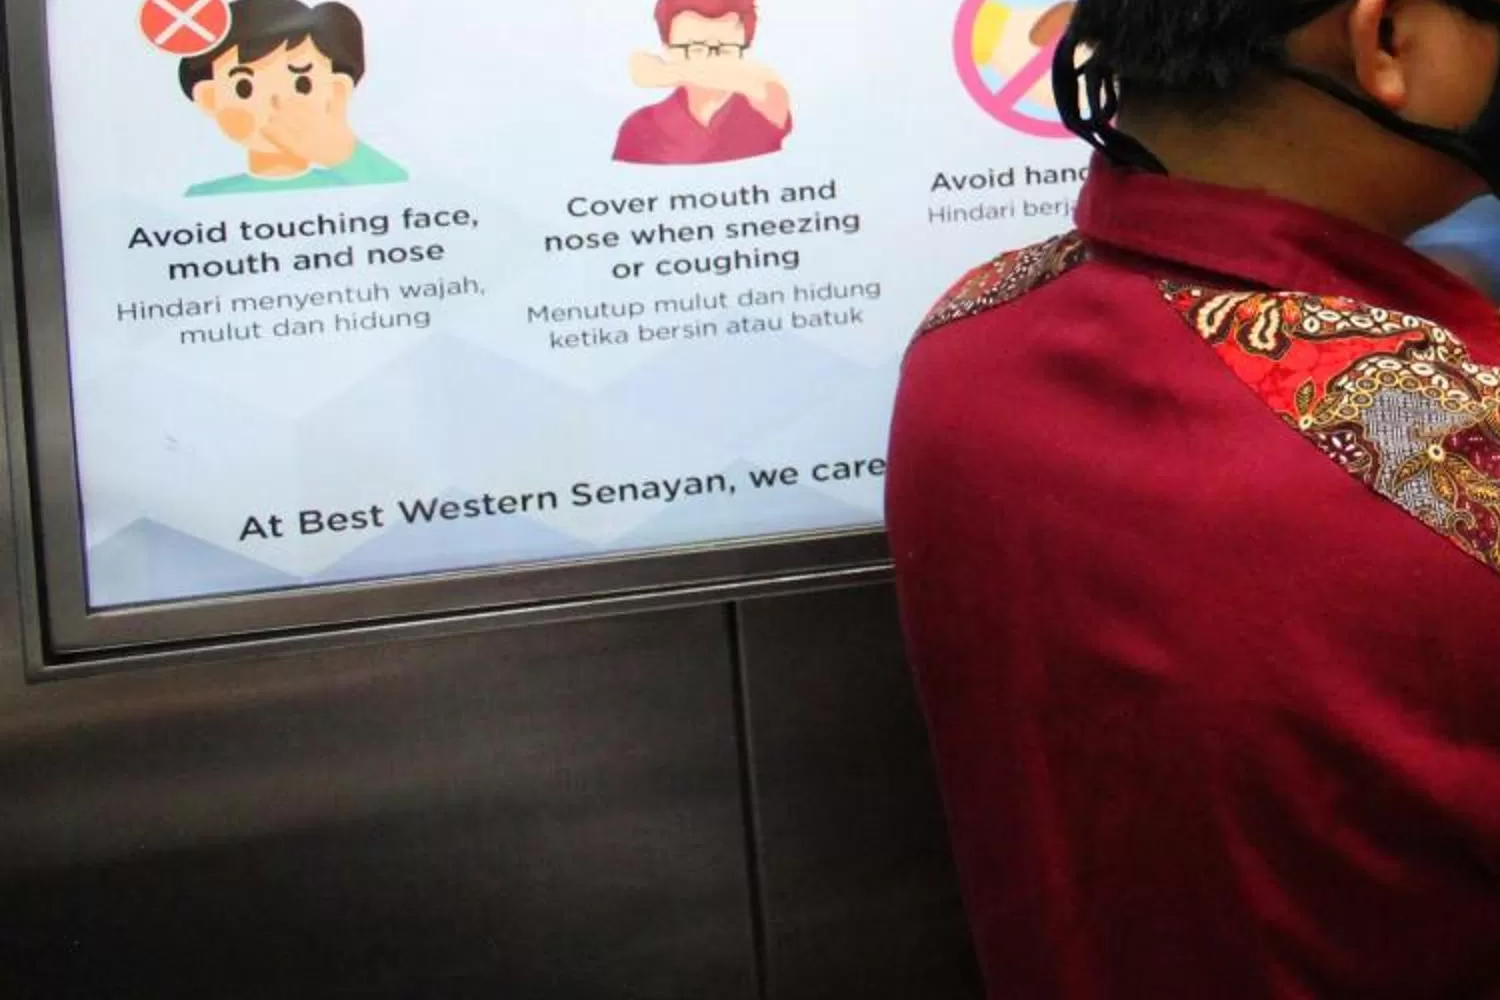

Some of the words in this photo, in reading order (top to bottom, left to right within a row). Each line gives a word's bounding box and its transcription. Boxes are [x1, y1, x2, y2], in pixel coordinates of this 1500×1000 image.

[566, 196, 659, 218] Cover
[669, 183, 770, 211] mouth
[780, 179, 837, 203] and
[930, 167, 1015, 193] Avoid
[127, 220, 227, 249] Avoid
[239, 212, 390, 241] touching
[401, 207, 479, 230] face,
[927, 202, 1015, 224] Hindari
[1023, 198, 1076, 218] berj
[544, 231, 620, 253] nose
[630, 223, 714, 246] when
[725, 211, 861, 239] sneezing
[168, 251, 280, 281] mouth
[293, 245, 354, 271] and
[367, 244, 445, 265] nose
[611, 261, 645, 280] or
[655, 247, 800, 277] coughing
[116, 295, 221, 322] Hindari
[230, 281, 390, 313] menyentuh
[399, 275, 485, 301] wajah,
[527, 301, 646, 324] Menutup
[653, 291, 728, 314] mulut
[737, 288, 785, 308] dan
[793, 281, 881, 303] hidung
[179, 321, 261, 345] mulut
[272, 317, 325, 337] dan
[334, 311, 432, 332] hidung
[549, 327, 629, 349] ketika
[637, 321, 718, 343] bersin
[725, 316, 783, 336] atau
[791, 306, 864, 329] batuk
[239, 514, 284, 542] At
[298, 504, 384, 536] Best
[397, 490, 558, 525] Western
[571, 473, 736, 507] Senayan,
[748, 466, 799, 489] we
